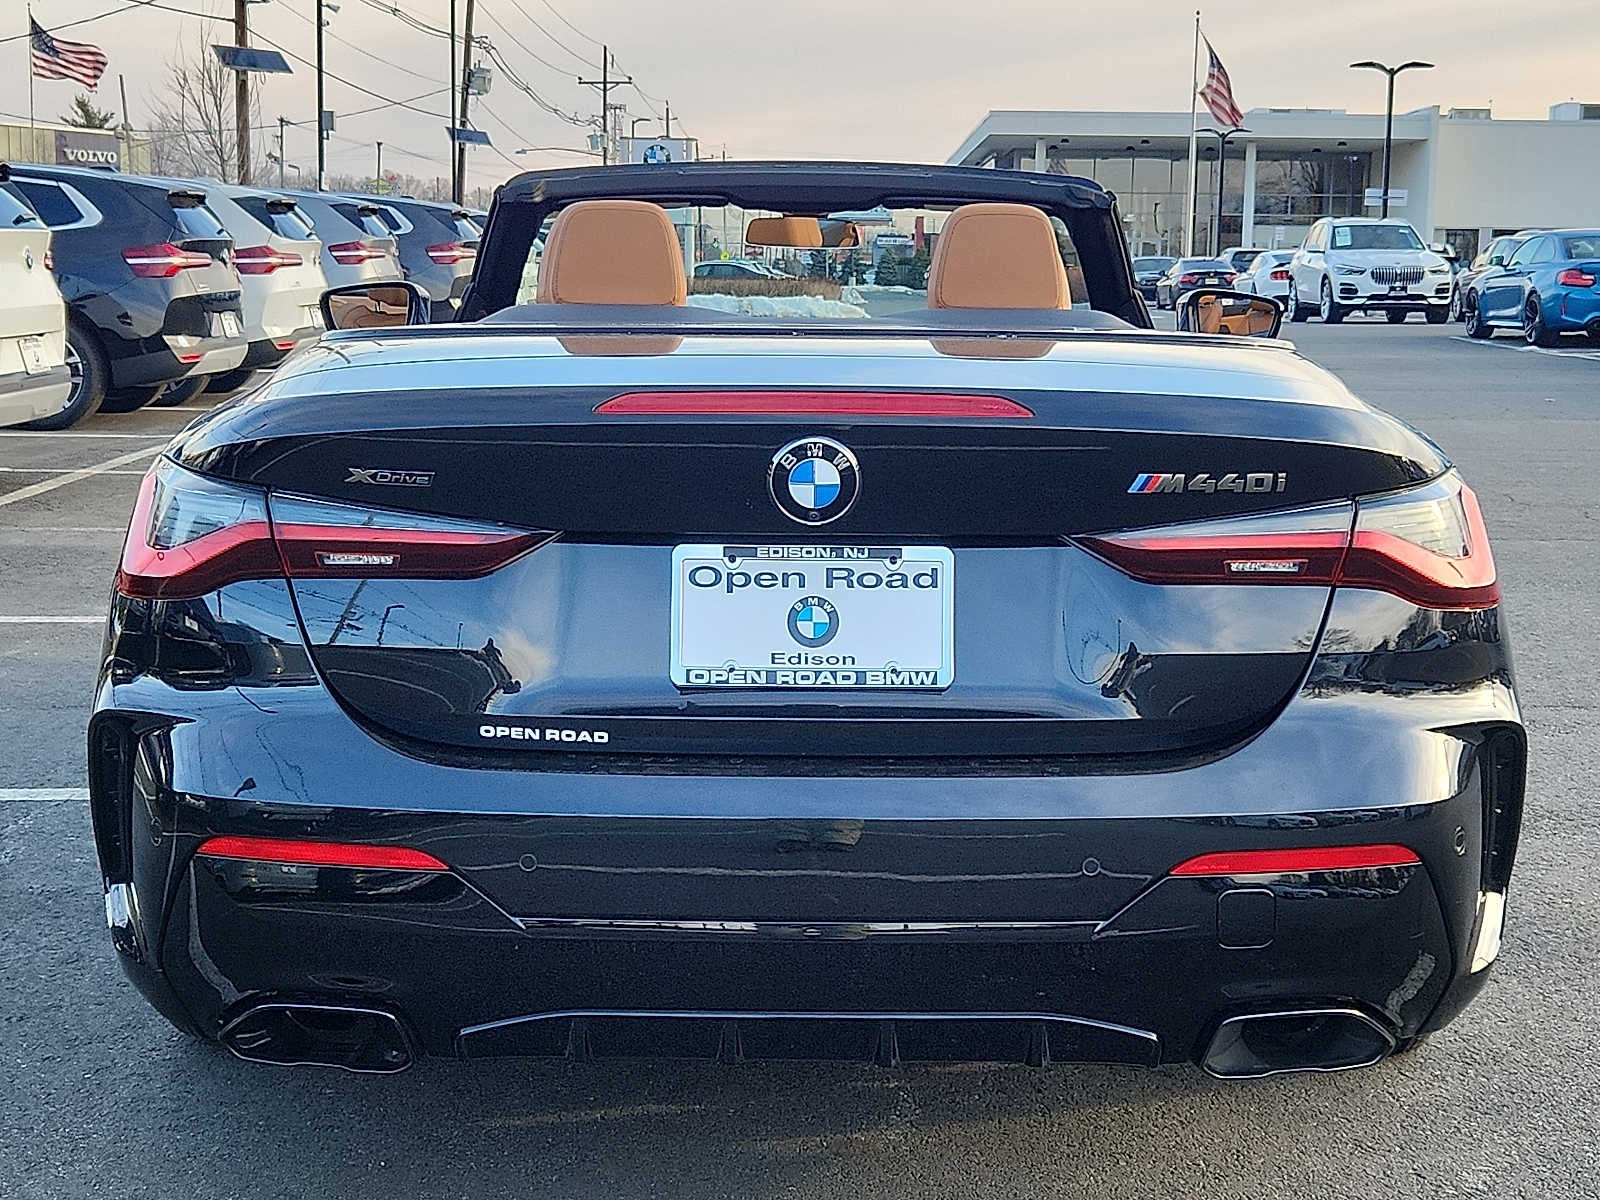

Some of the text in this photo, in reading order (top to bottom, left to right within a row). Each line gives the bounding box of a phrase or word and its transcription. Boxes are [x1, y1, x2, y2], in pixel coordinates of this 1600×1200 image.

[63, 148, 117, 164] VOLVO
[780, 443, 850, 470] BMW
[1153, 473, 1287, 493] M440i
[756, 547, 869, 559] EDISON, NJ
[688, 565, 939, 594] Open Road
[793, 597, 835, 613] BMW
[770, 652, 856, 666] Edison
[689, 670, 936, 686] OPEN ROAD BMW
[479, 725, 609, 743] OPEN ROAD
